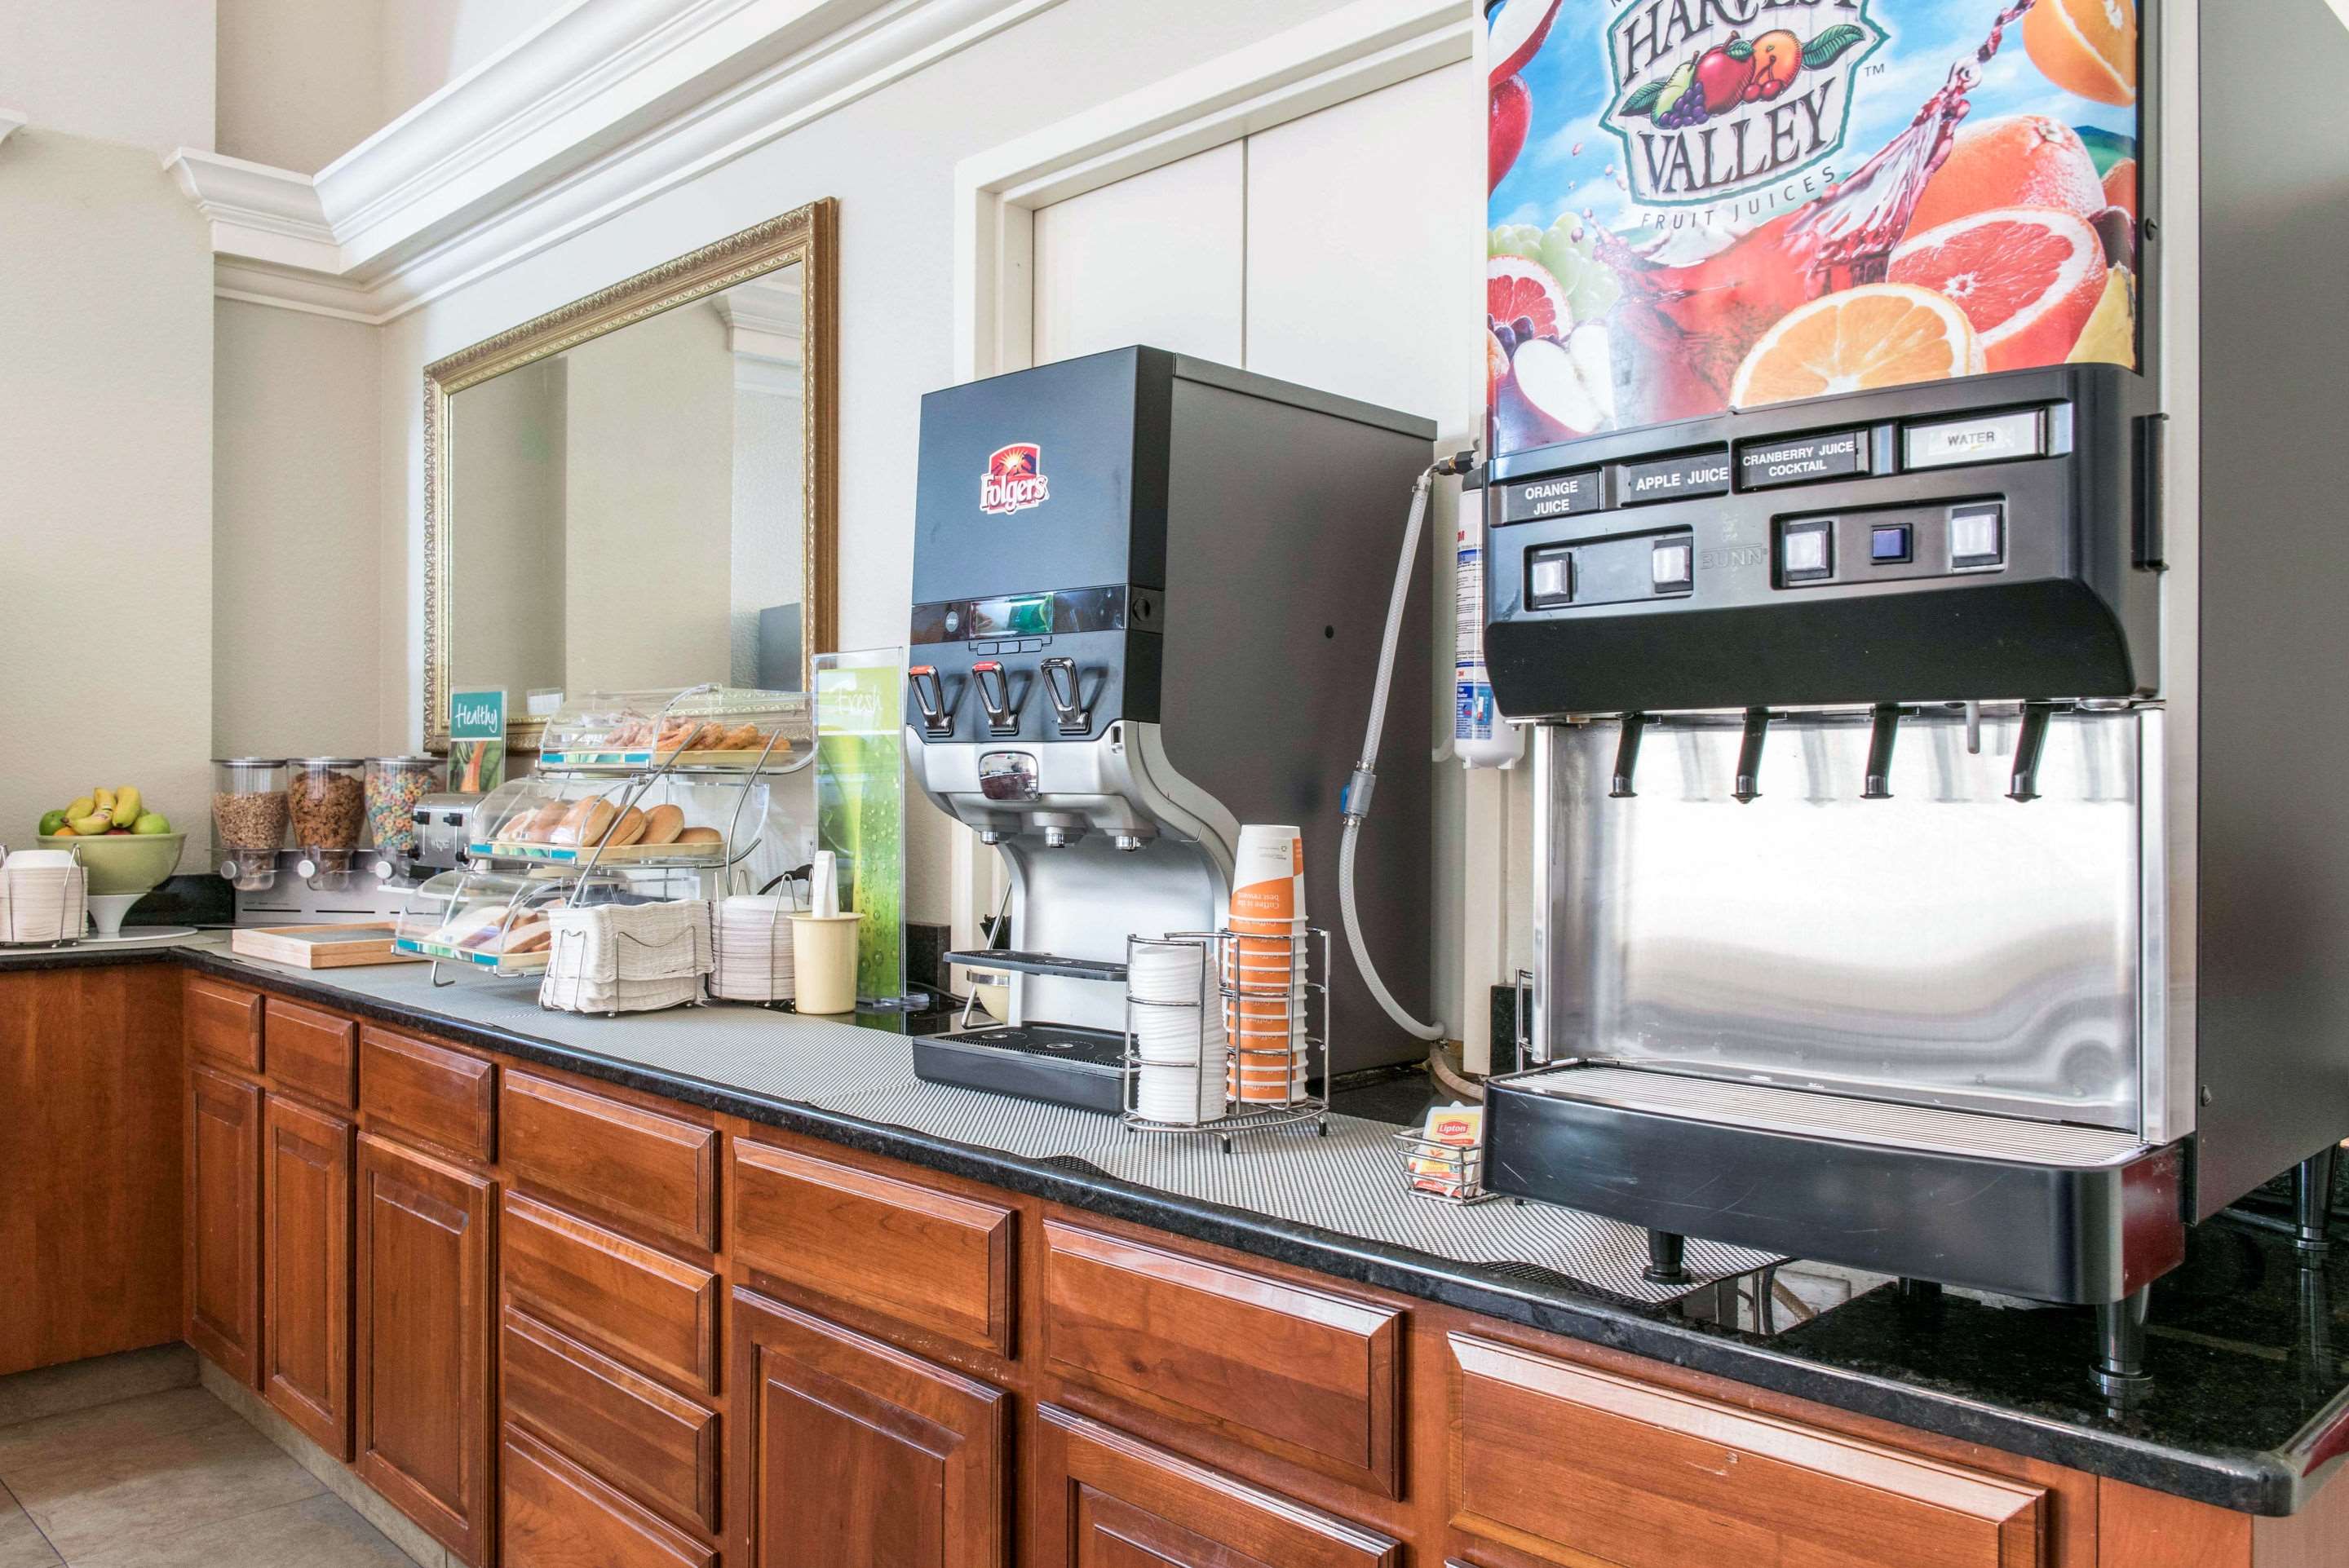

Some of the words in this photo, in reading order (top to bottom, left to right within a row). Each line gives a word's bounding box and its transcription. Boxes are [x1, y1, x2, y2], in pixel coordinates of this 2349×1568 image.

[1639, 77, 1837, 194] VALLEY
[1642, 210, 1714, 229] FRUIT
[1733, 166, 1835, 222] JUICES
[1948, 431, 1995, 446] WATER
[1742, 446, 1814, 466] CRANBERRY
[1819, 440, 1855, 456] JUICE
[1635, 473, 1681, 491] APPLE
[1687, 466, 1728, 485] JUICE
[1768, 459, 1827, 477] COCKTAIL
[981, 475, 1046, 512] Folgers
[1524, 480, 1578, 500] ORANGE
[1533, 499, 1570, 515] JUICE
[1700, 546, 1763, 569] BUNN
[834, 684, 883, 715] Fresh
[455, 703, 498, 733] Healthy
[1439, 1124, 1466, 1133] Lipton
